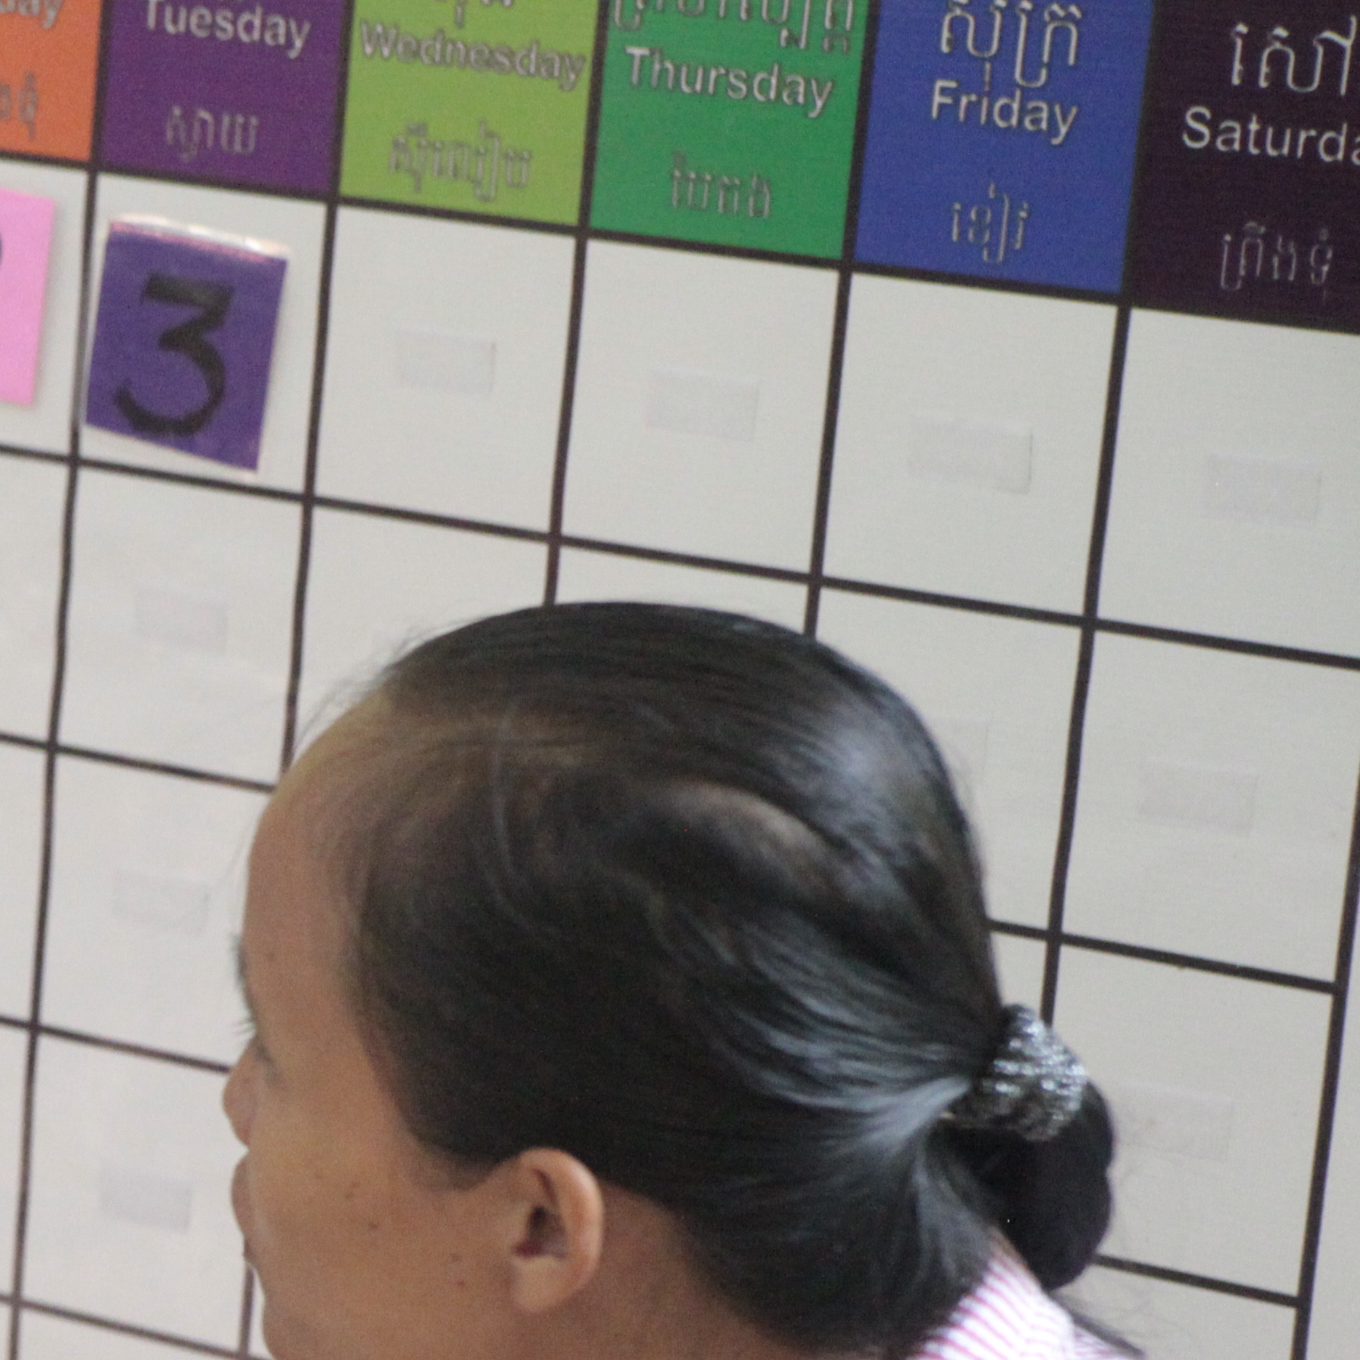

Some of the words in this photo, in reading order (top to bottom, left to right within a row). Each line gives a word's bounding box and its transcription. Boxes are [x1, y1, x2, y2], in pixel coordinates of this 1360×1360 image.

[146, 0, 311, 59] Tuesday
[360, 19, 586, 91] Wednesday
[625, 46, 833, 118] Thursday
[931, 79, 1078, 146] Friday
[113, 272, 235, 440] 3
